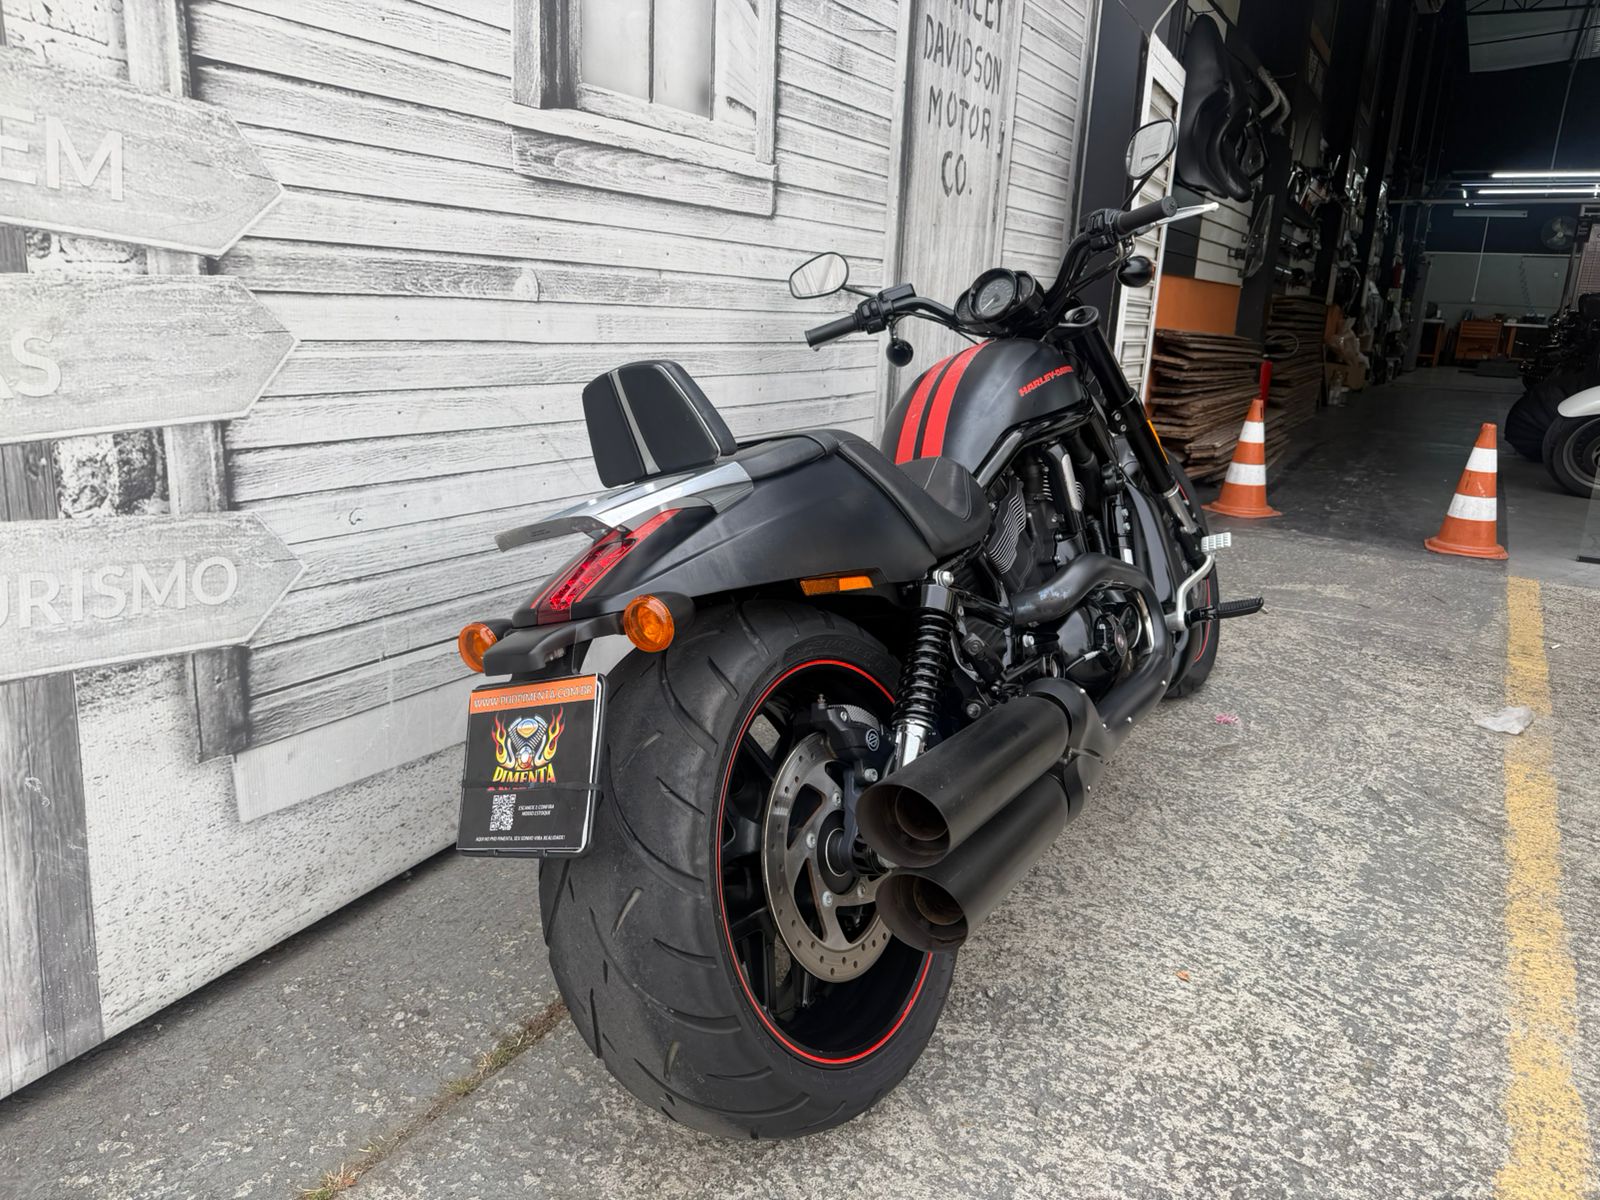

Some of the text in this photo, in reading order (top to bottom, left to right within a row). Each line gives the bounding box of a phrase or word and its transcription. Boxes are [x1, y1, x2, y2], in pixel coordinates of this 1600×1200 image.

[924, 14, 1002, 95] DAVIDSON
[928, 85, 991, 149] MOTOR
[941, 151, 972, 197] CO.
[0, 556, 239, 629] RISMO
